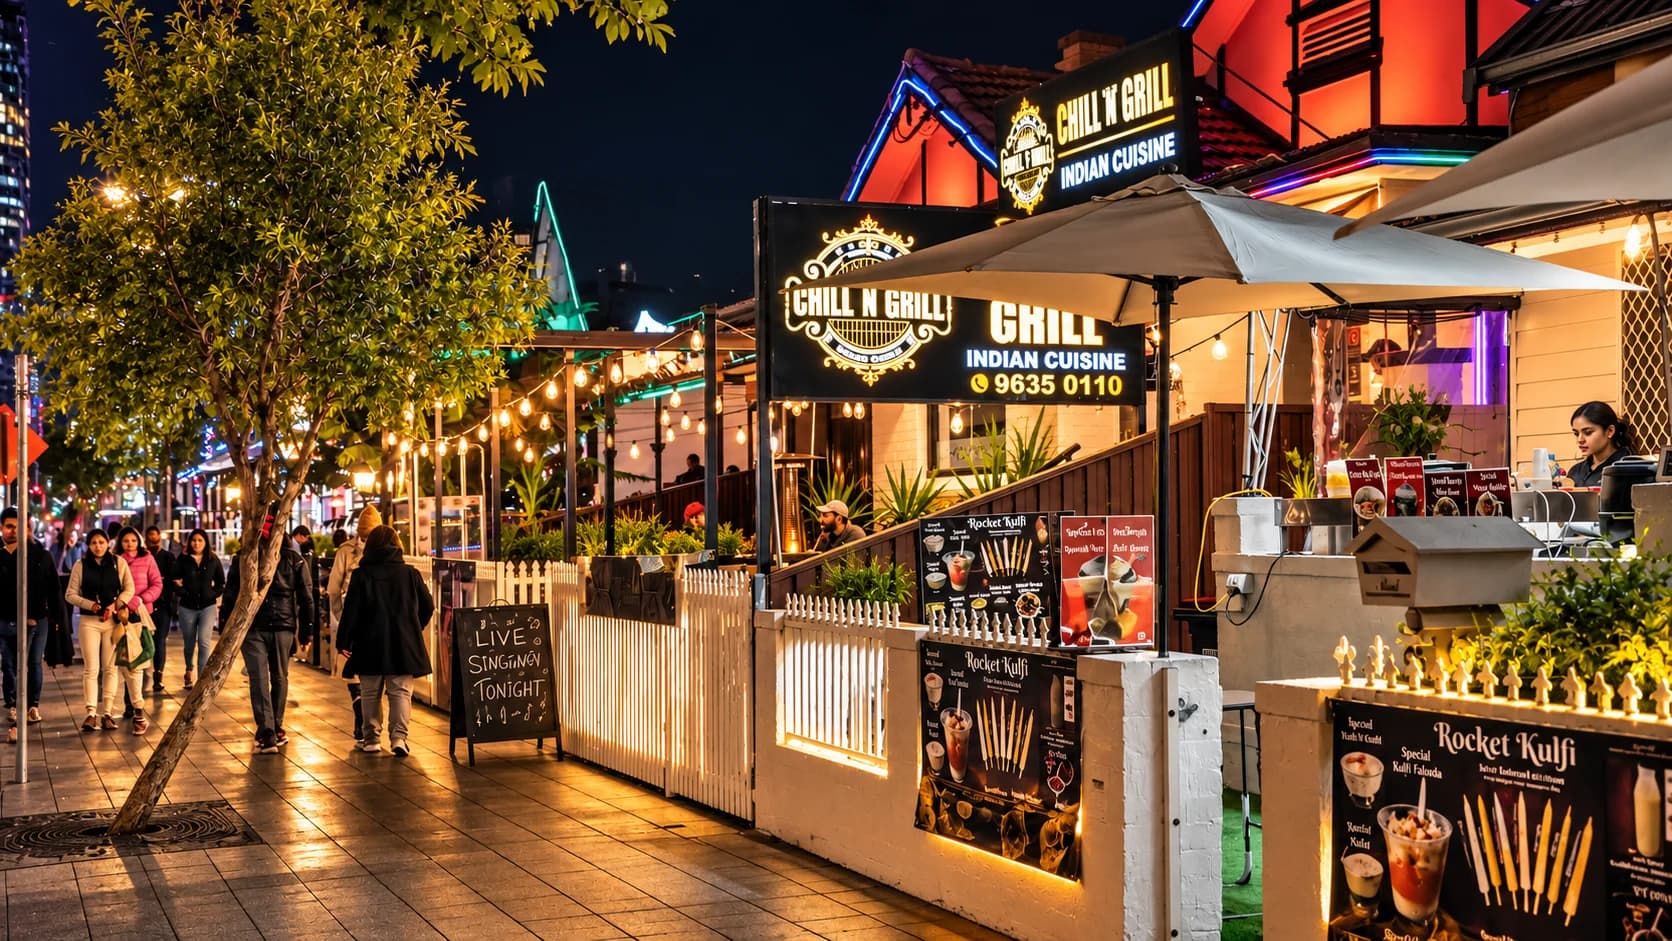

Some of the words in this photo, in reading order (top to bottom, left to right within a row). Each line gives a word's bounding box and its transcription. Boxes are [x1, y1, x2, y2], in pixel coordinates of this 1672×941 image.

[1056, 89, 1102, 146] CHILL
[1121, 62, 1175, 122] GRILL
[1060, 154, 1109, 189] INDIAN
[1112, 132, 1175, 173] CUISINE
[793, 286, 855, 316] CHILL
[861, 288, 878, 317] N
[884, 290, 945, 321] GRILL
[990, 300, 1104, 346] GRILL
[966, 349, 1038, 369] INDIAN
[1044, 351, 1127, 371] CUISINE
[994, 373, 1056, 395] 9635
[1063, 374, 1123, 396] 0110
[967, 517, 1001, 530] Rocket
[476, 627, 527, 647] LIVE
[964, 651, 1000, 674] Rocket
[1001, 656, 1029, 680] Kulfi
[473, 677, 546, 702] TONIGHT
[1401, 746, 1431, 761] Special
[1433, 721, 1511, 760] Rocket
[1515, 732, 1577, 772] Kulfi
